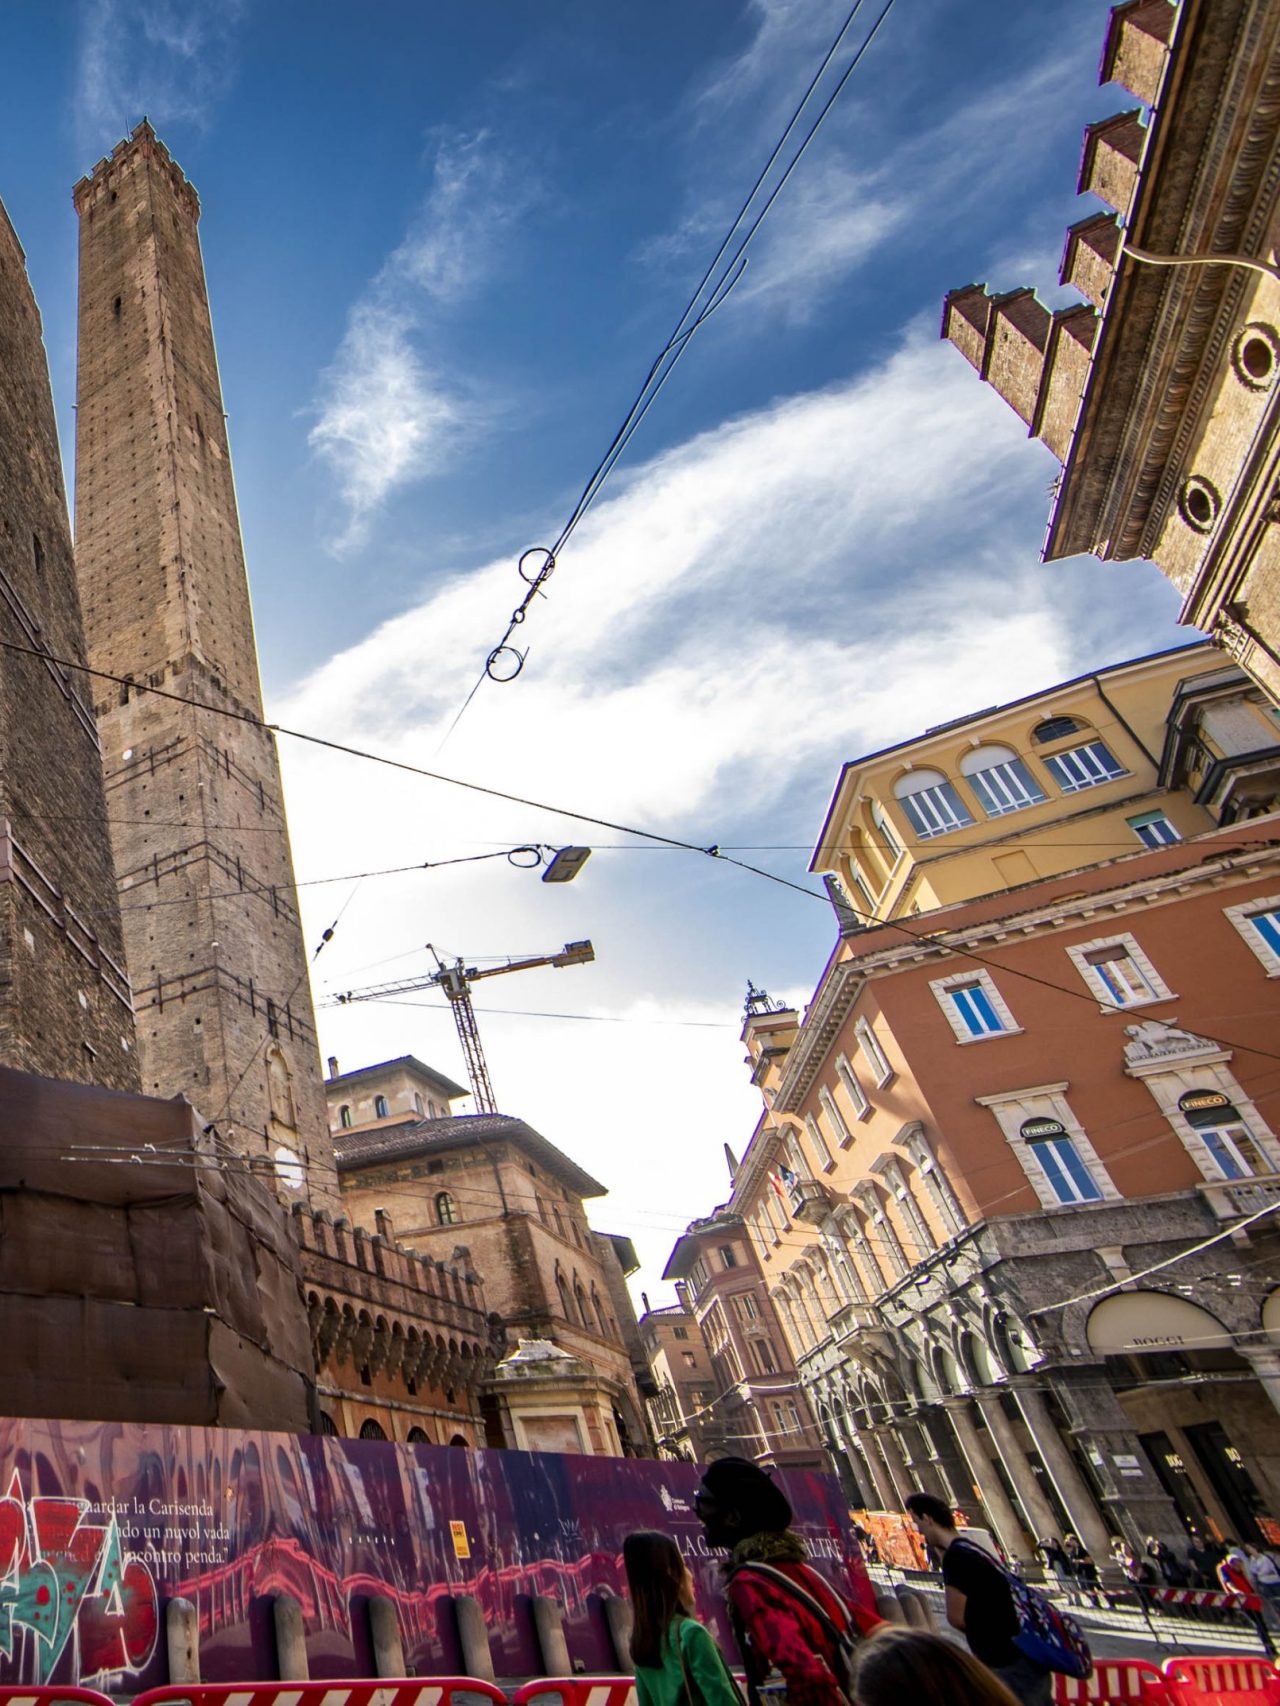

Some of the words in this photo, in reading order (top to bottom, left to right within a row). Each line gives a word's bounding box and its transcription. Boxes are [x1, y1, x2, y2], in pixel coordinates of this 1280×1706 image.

[1185, 1097, 1223, 1108] FINECO
[1025, 1125, 1058, 1136] FINECO
[1132, 1335, 1185, 1346] BOGGI
[133, 1496, 145, 1515] la
[148, 1498, 214, 1516] Carisenda
[143, 1528, 161, 1539] un
[164, 1521, 200, 1540] nuvol
[203, 1521, 230, 1540] vada
[122, 1546, 182, 1562] incontro
